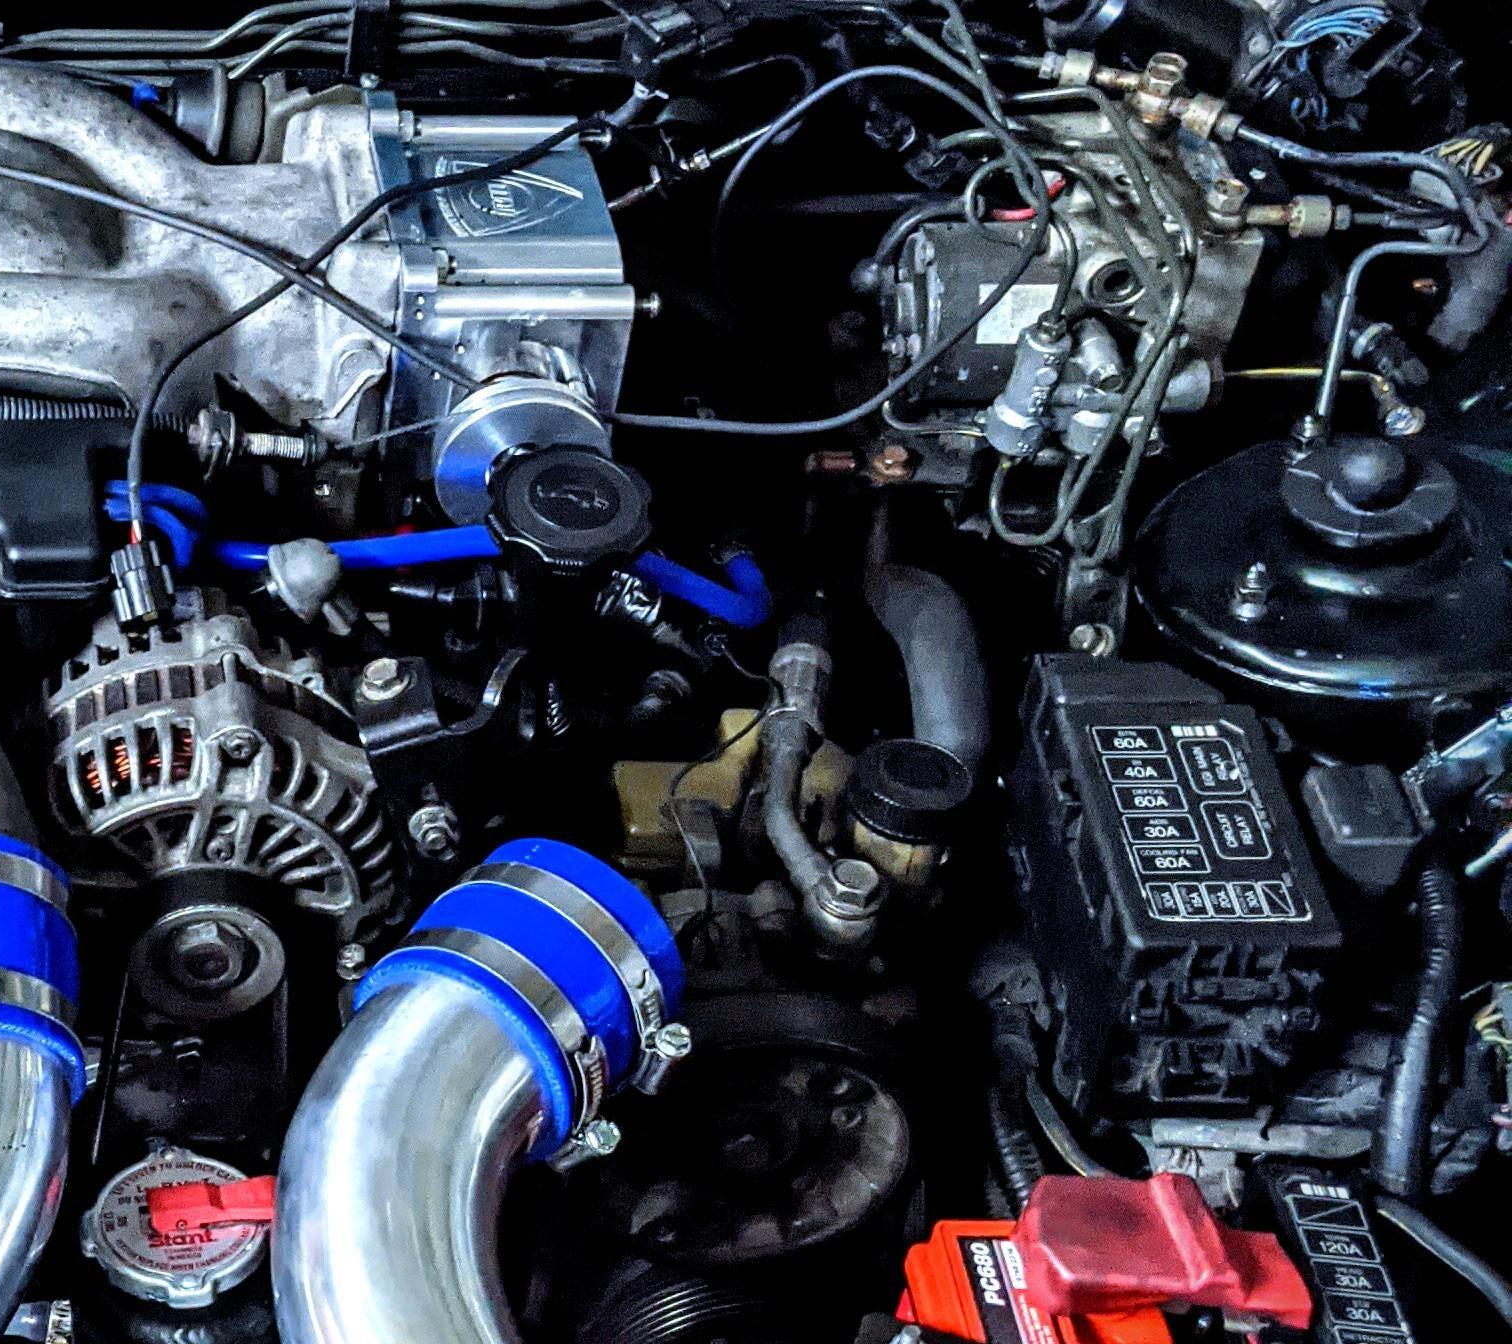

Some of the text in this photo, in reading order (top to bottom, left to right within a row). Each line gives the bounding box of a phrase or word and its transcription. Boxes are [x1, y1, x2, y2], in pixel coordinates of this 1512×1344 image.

[1112, 738, 1148, 749] 60A
[1124, 766, 1158, 777] 40A
[1133, 796, 1168, 807] 60A
[1143, 826, 1180, 838] 30A
[1233, 814, 1255, 845] RELAY
[1154, 857, 1191, 869] 60A
[148, 1230, 212, 1248] Stant
[1319, 1241, 1363, 1256] 120A
[970, 1242, 1007, 1307] PC680
[1335, 1274, 1372, 1289] 30A
[1345, 1307, 1384, 1323] 30A
